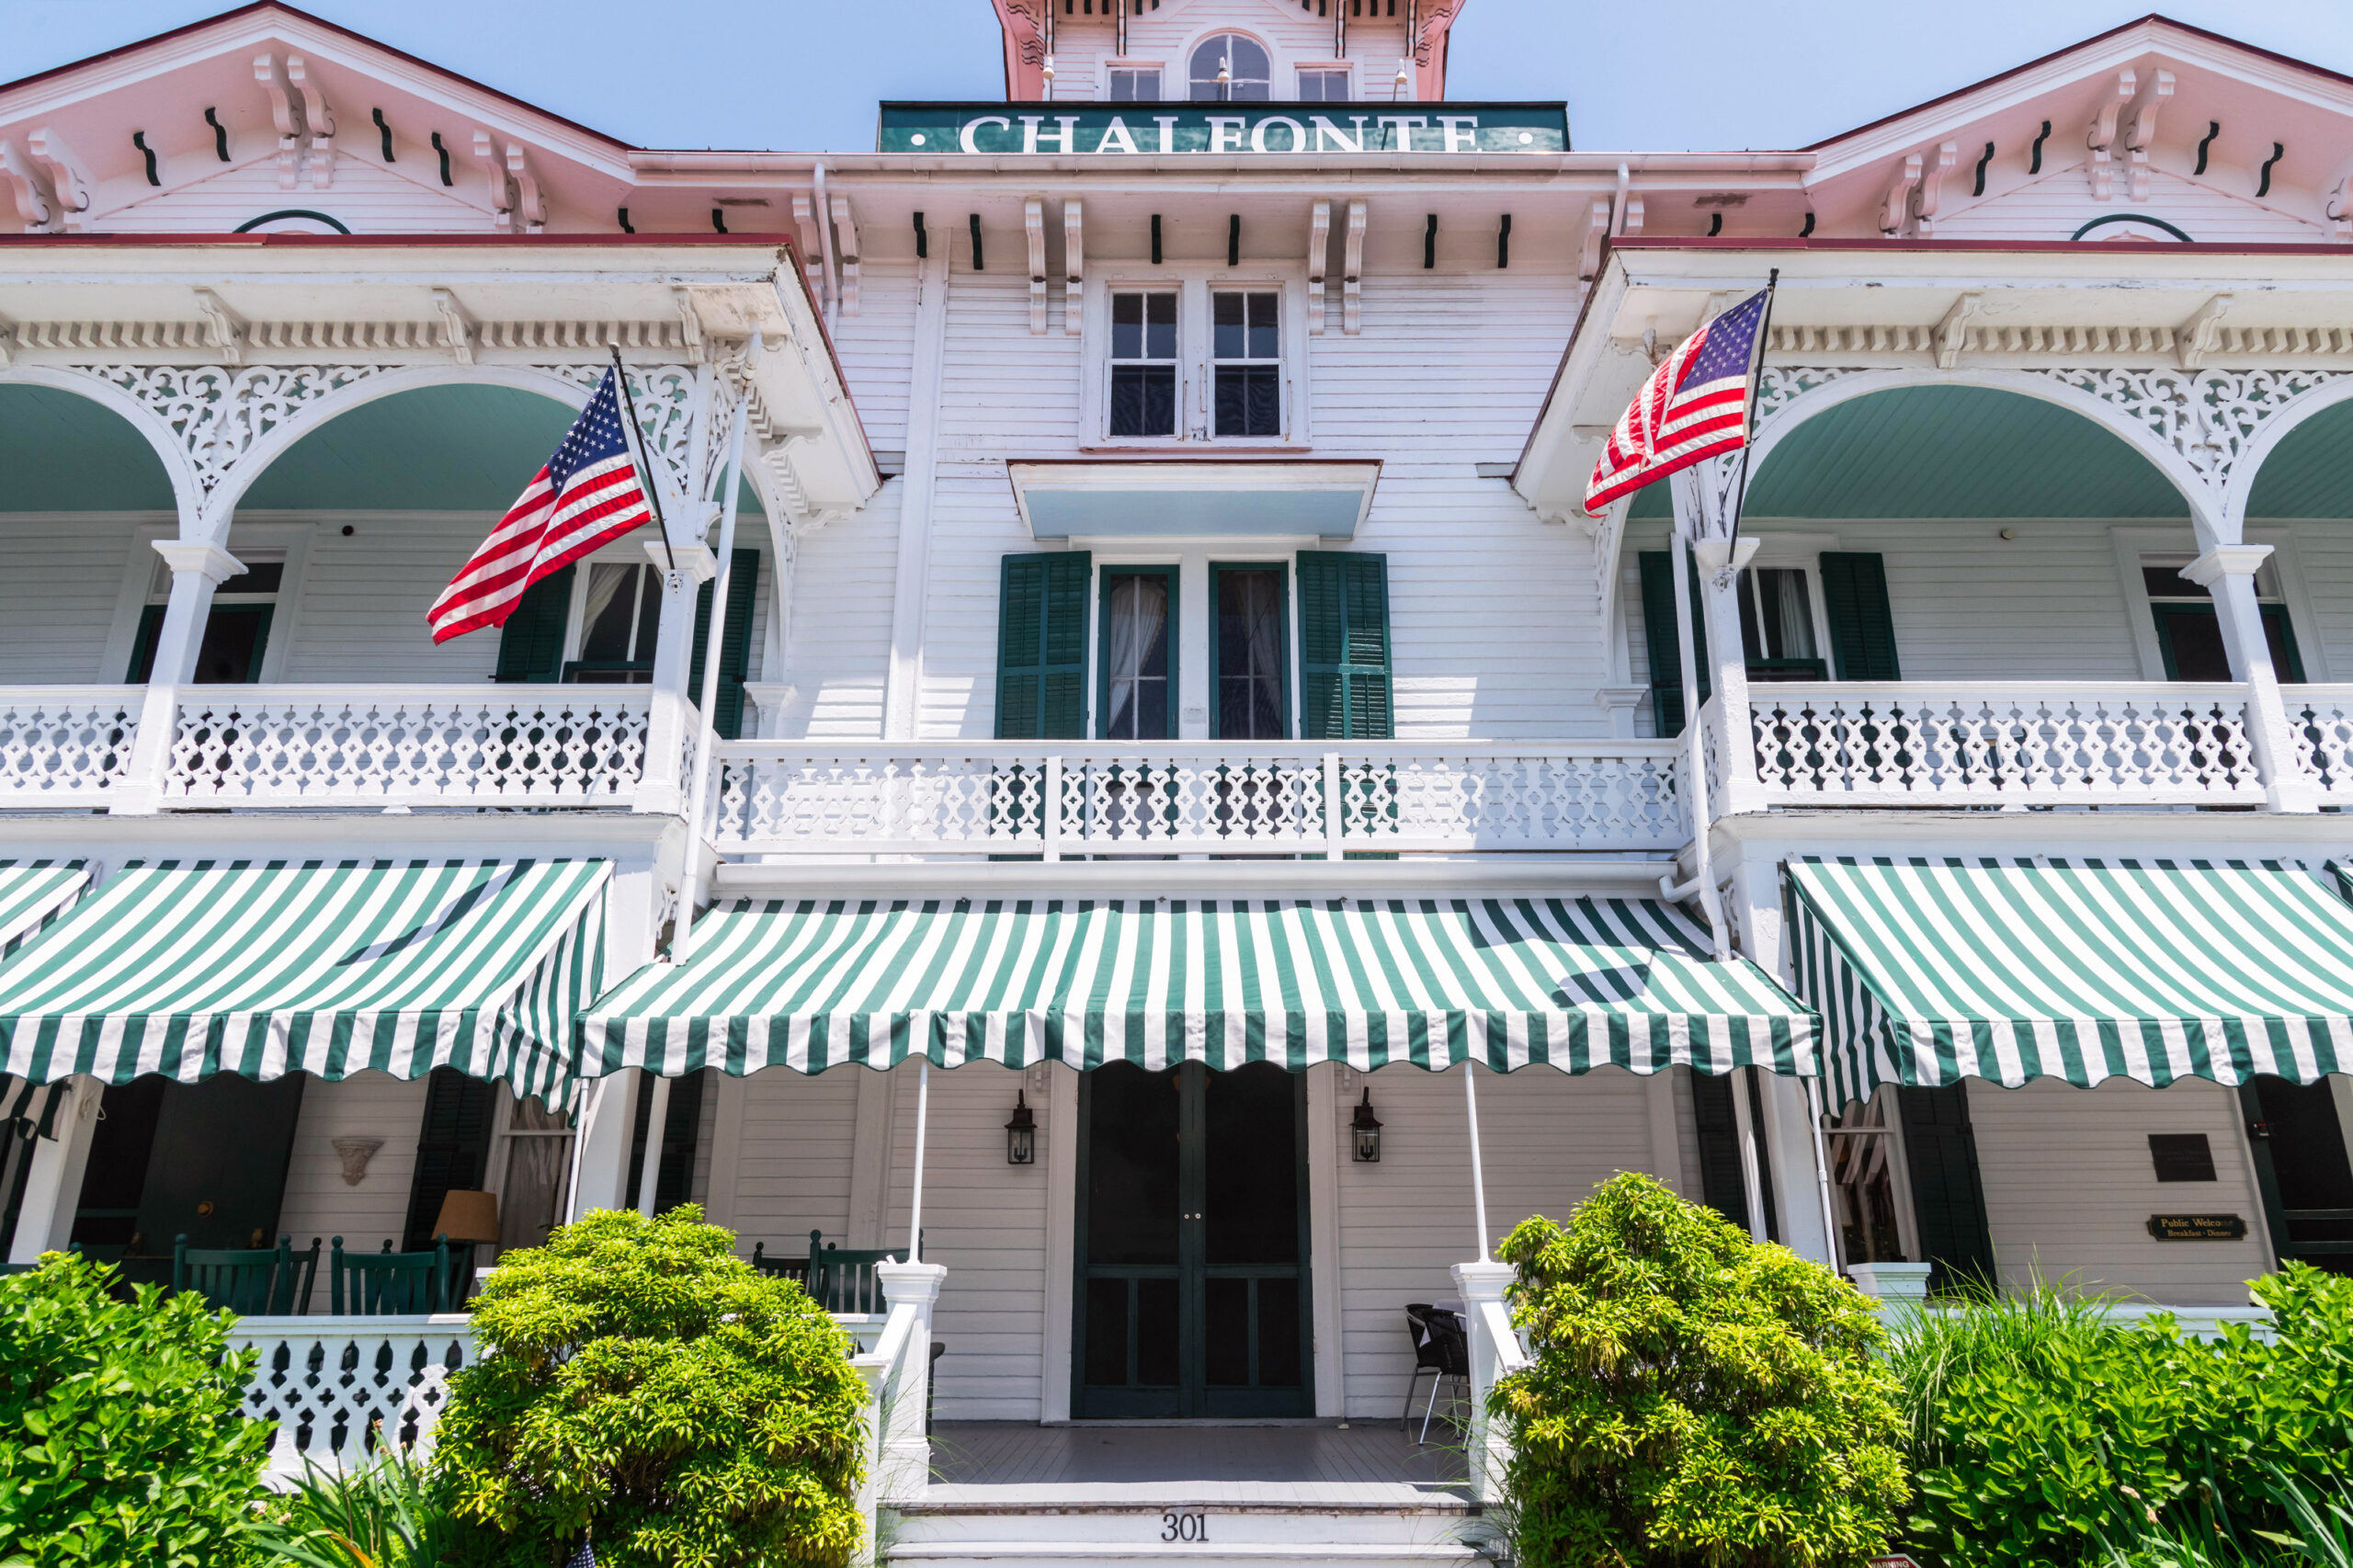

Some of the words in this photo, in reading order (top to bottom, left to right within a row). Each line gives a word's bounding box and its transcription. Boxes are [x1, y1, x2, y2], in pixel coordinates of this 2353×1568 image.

[960, 116, 1483, 153] CHALFONTE
[2161, 1218, 2189, 1228] Public
[2167, 1229, 2201, 1237] Breakfast
[2207, 1229, 2232, 1237] Dinner
[1161, 1513, 1210, 1541] 301
